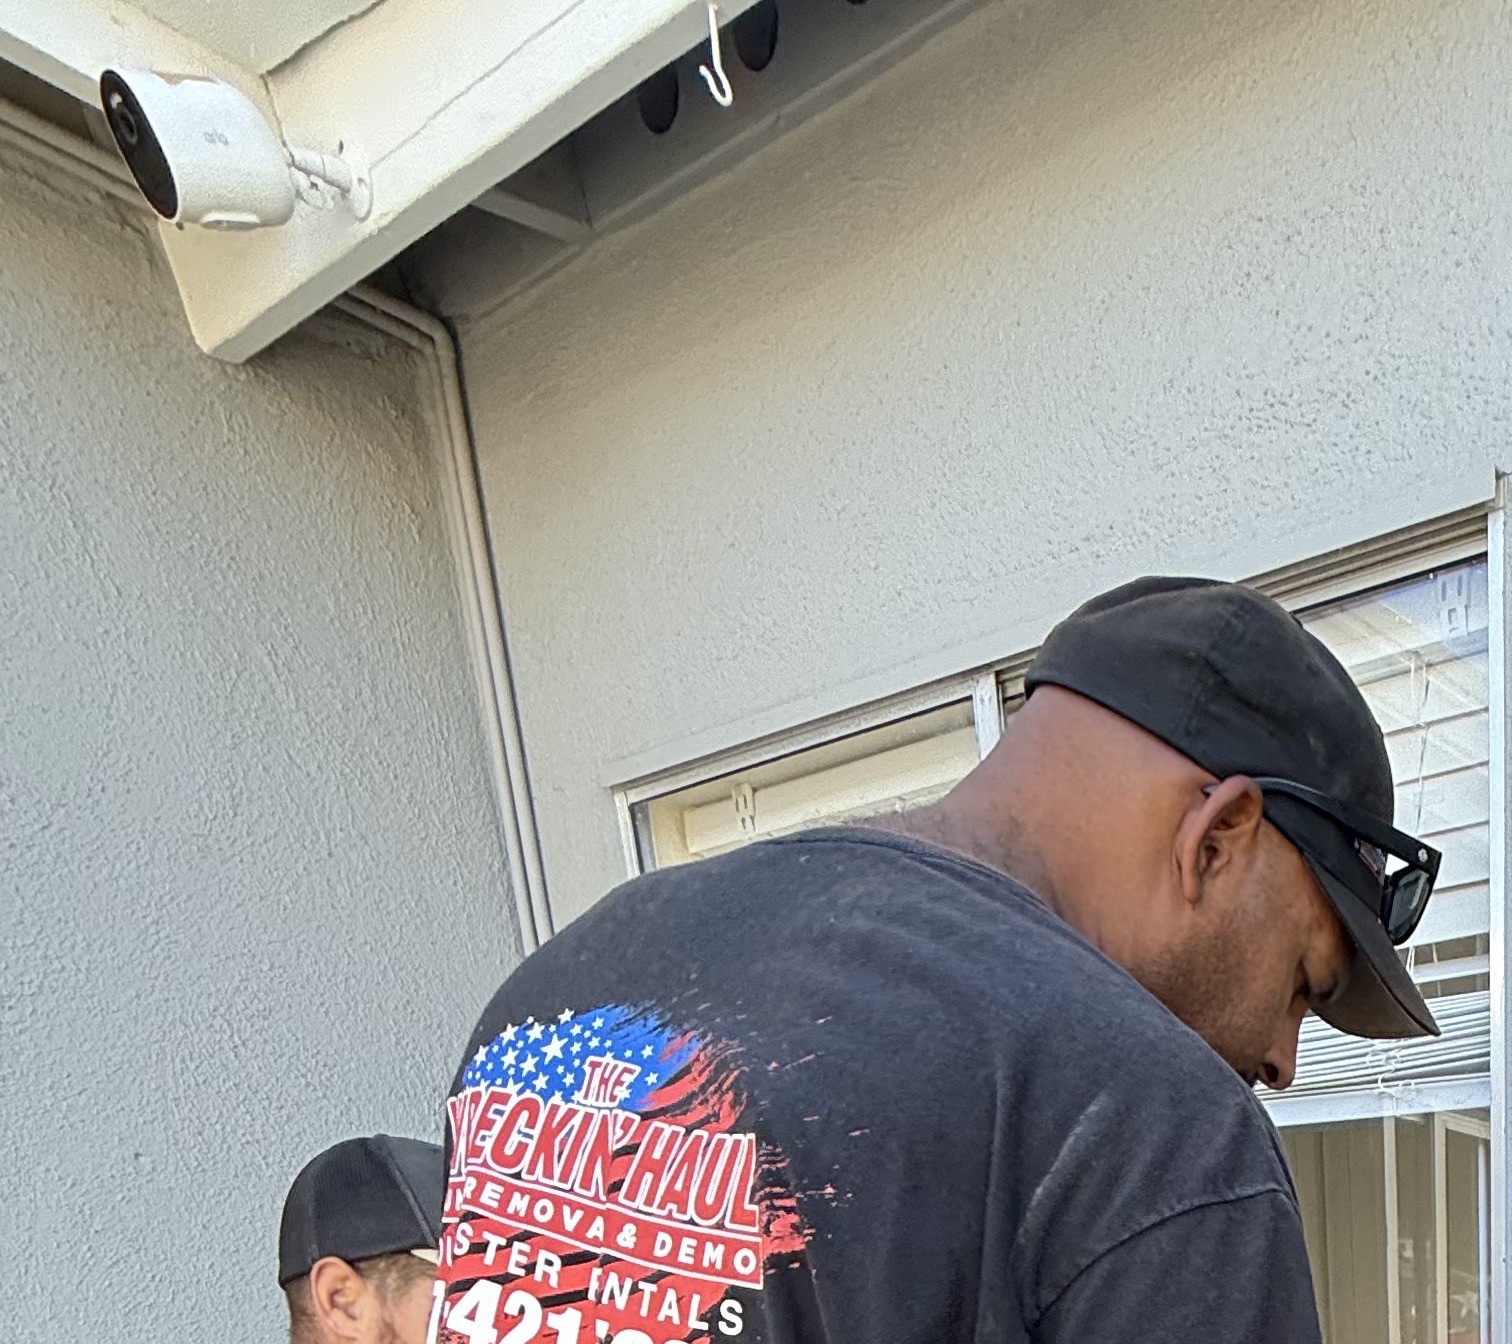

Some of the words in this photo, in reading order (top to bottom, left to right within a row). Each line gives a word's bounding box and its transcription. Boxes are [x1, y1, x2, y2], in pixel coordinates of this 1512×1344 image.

[581, 1056, 641, 1107] THE
[463, 1175, 605, 1242] REMOVA
[616, 1222, 637, 1249] &
[653, 1231, 757, 1275] DEMO
[618, 1120, 759, 1233] HAUL
